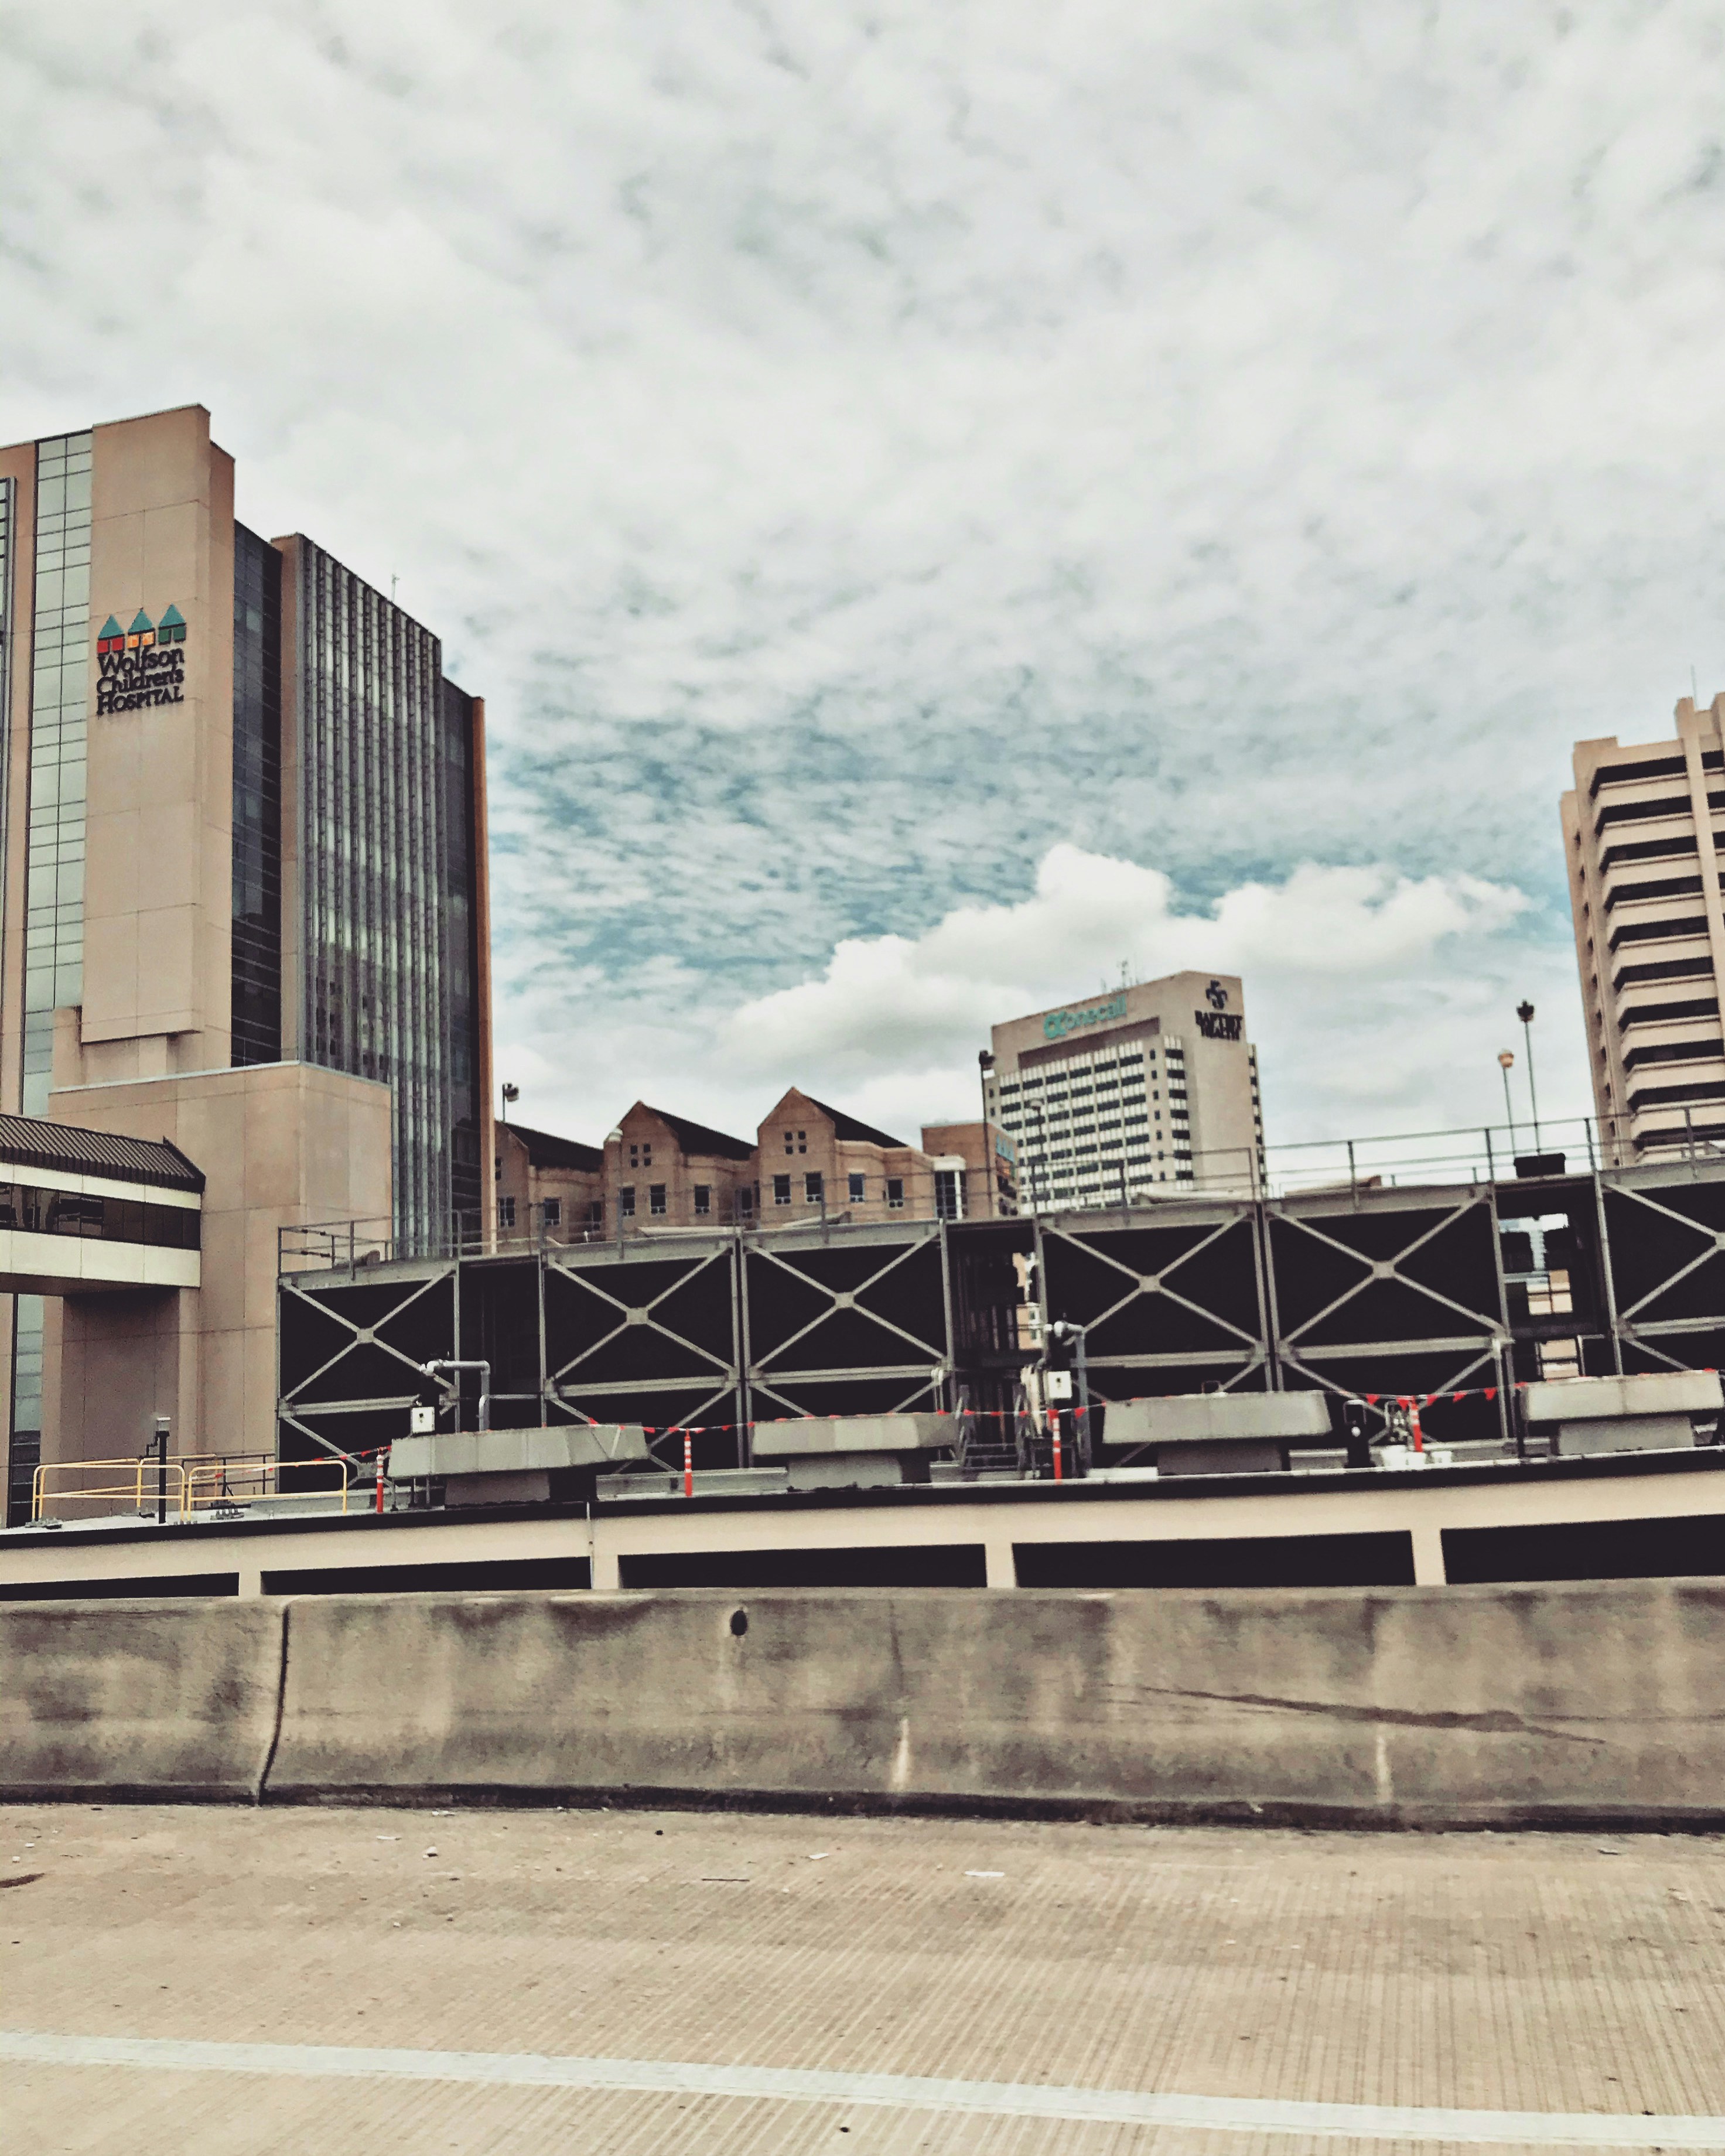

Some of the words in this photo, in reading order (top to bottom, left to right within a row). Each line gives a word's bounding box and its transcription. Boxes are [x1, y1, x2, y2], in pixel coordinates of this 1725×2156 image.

[97, 647, 185, 676] Wolfson
[97, 664, 185, 695] Children's
[97, 686, 185, 716] HOSPITAL
